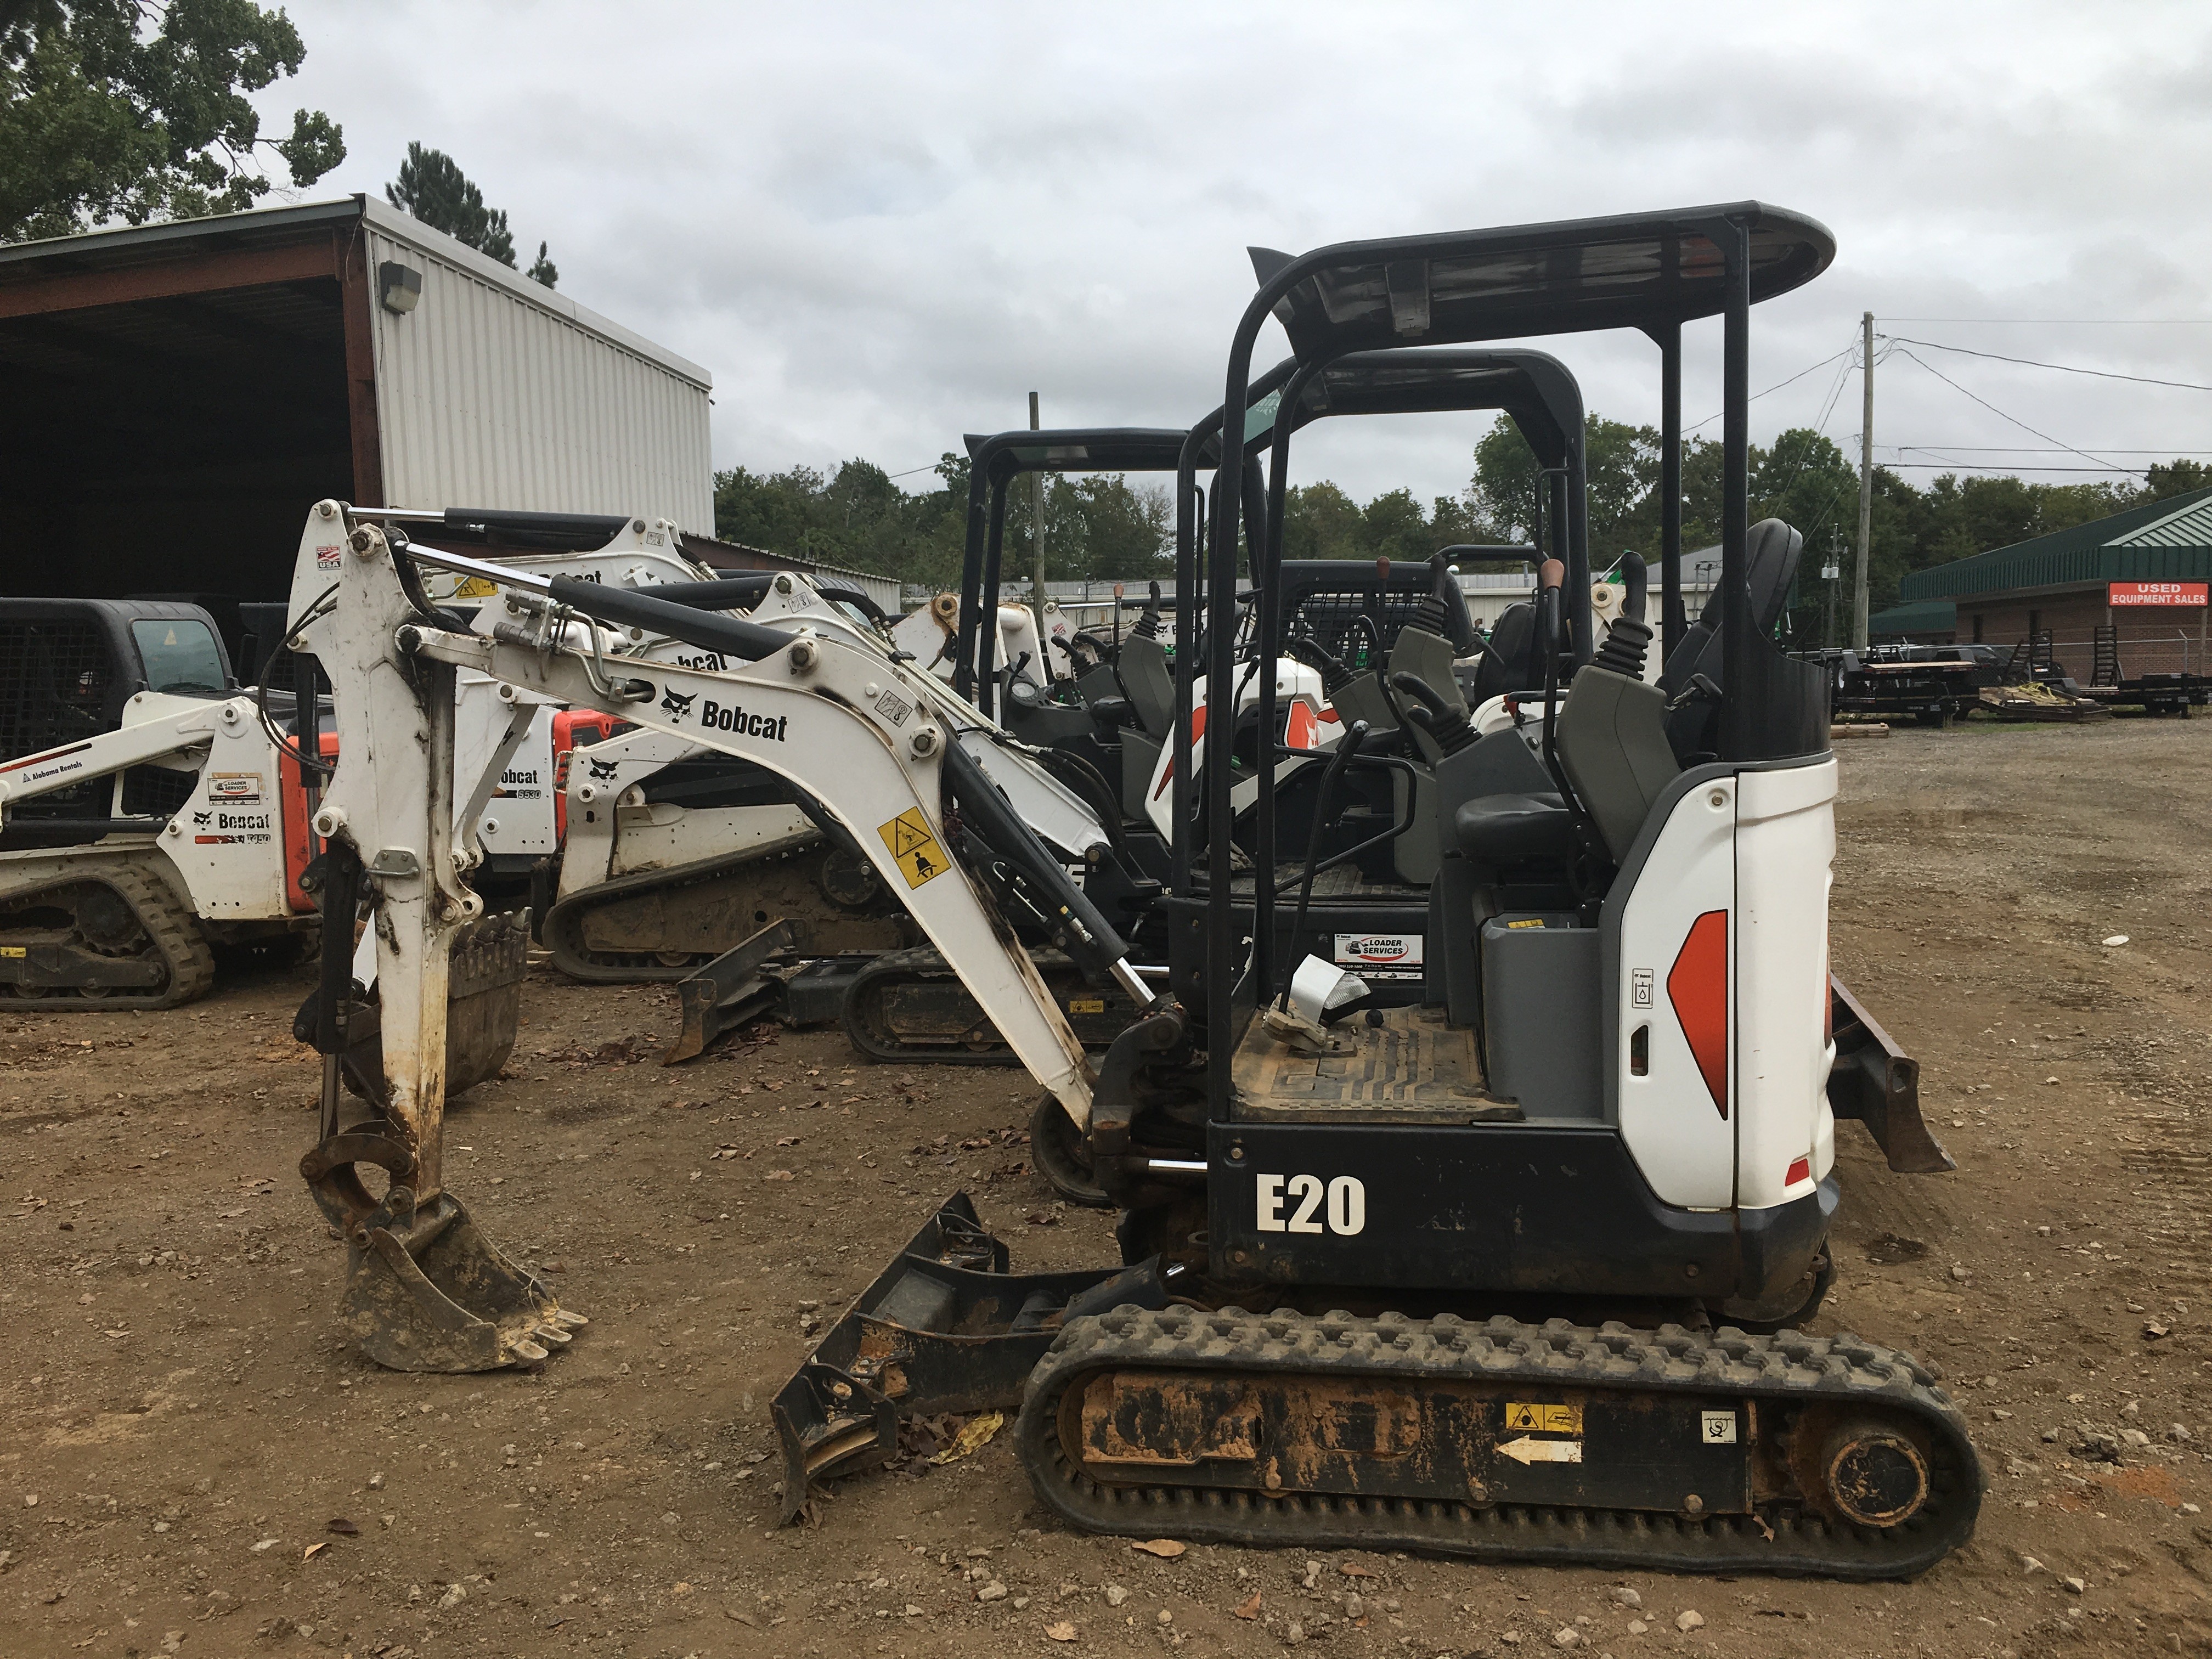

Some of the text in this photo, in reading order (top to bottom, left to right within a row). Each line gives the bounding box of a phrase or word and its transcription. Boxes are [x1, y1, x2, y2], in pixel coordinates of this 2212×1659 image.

[2137, 584, 2181, 593] USED
[2112, 594, 2205, 604] EQUIPMENT SALES
[701, 700, 788, 742] Bobcat
[32, 760, 82, 780] Alabama Rentals
[501, 769, 538, 784] obcat
[517, 789, 541, 799] S530
[1256, 1173, 1365, 1235] E20
